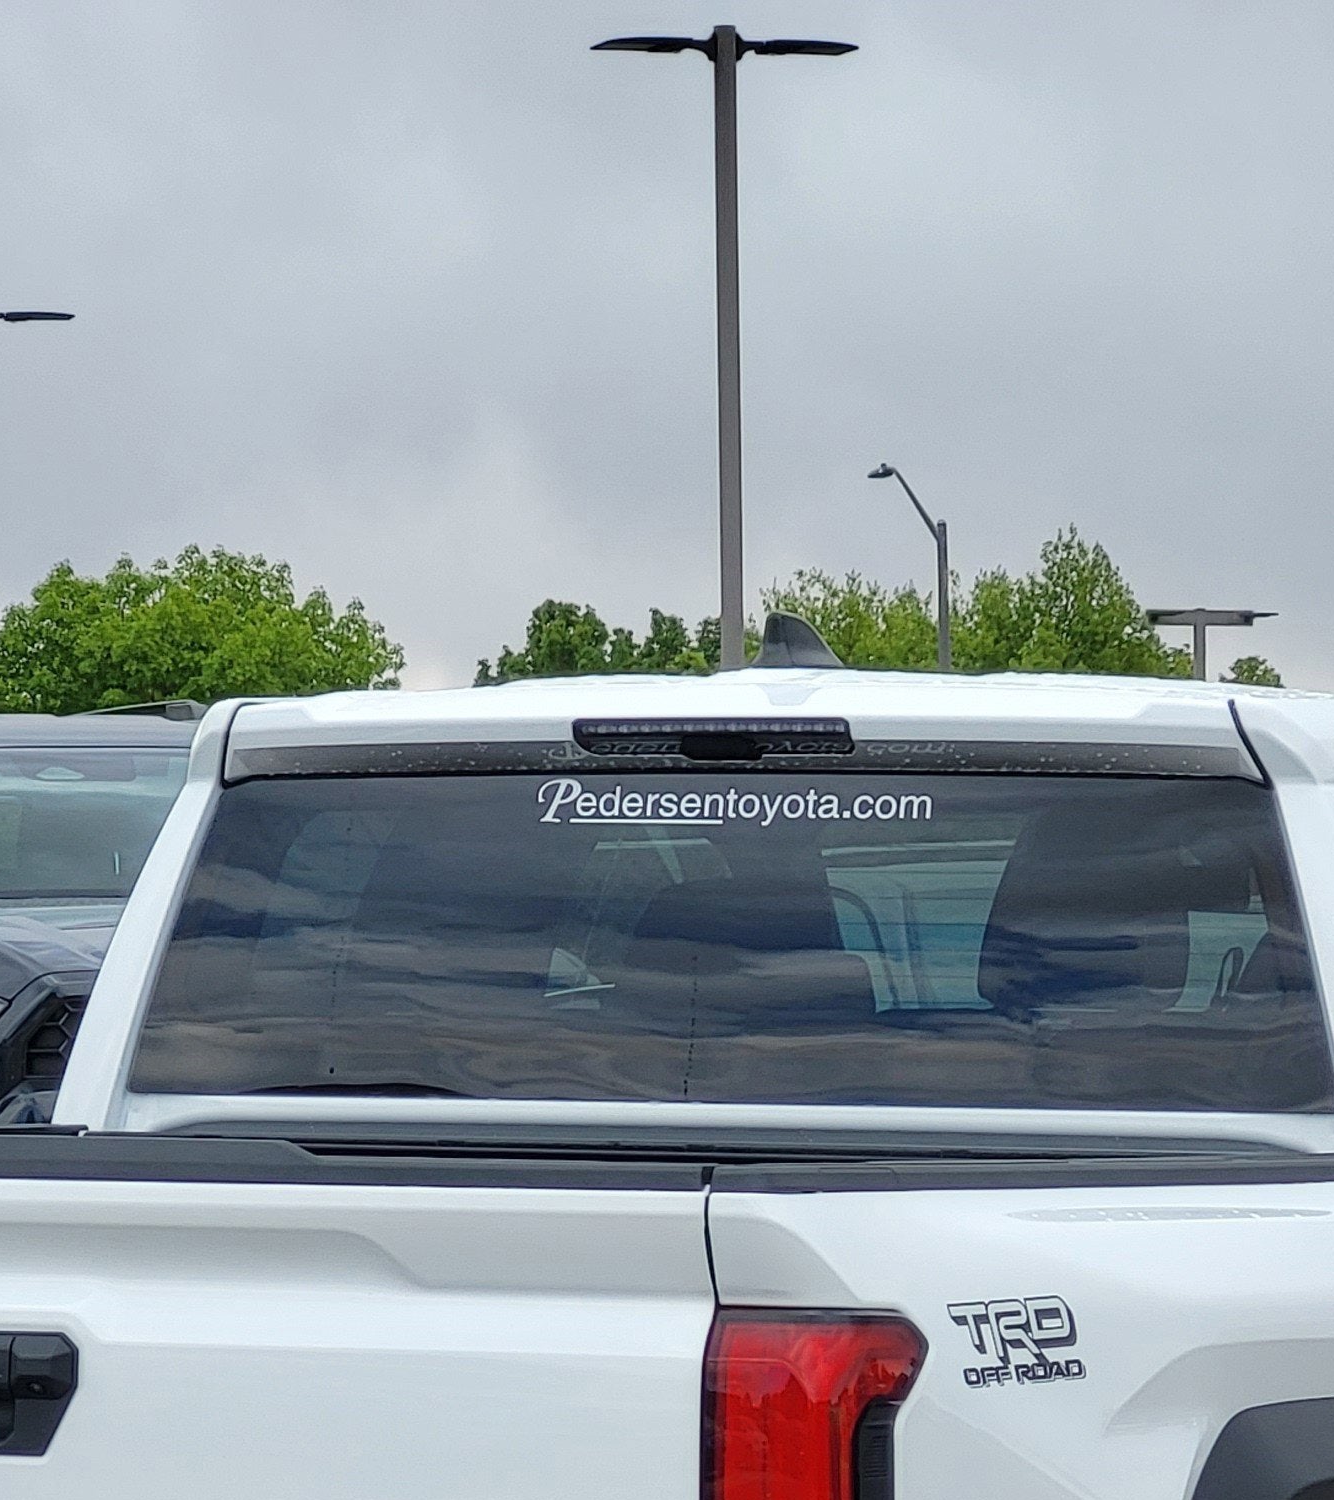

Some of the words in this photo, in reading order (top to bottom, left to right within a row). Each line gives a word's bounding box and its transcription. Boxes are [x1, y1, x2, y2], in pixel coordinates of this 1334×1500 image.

[538, 778, 933, 827] Pedersentoyota.com
[947, 1295, 1078, 1365] TRD
[963, 1367, 1013, 1389] OFF
[1014, 1359, 1087, 1385] ROAD
